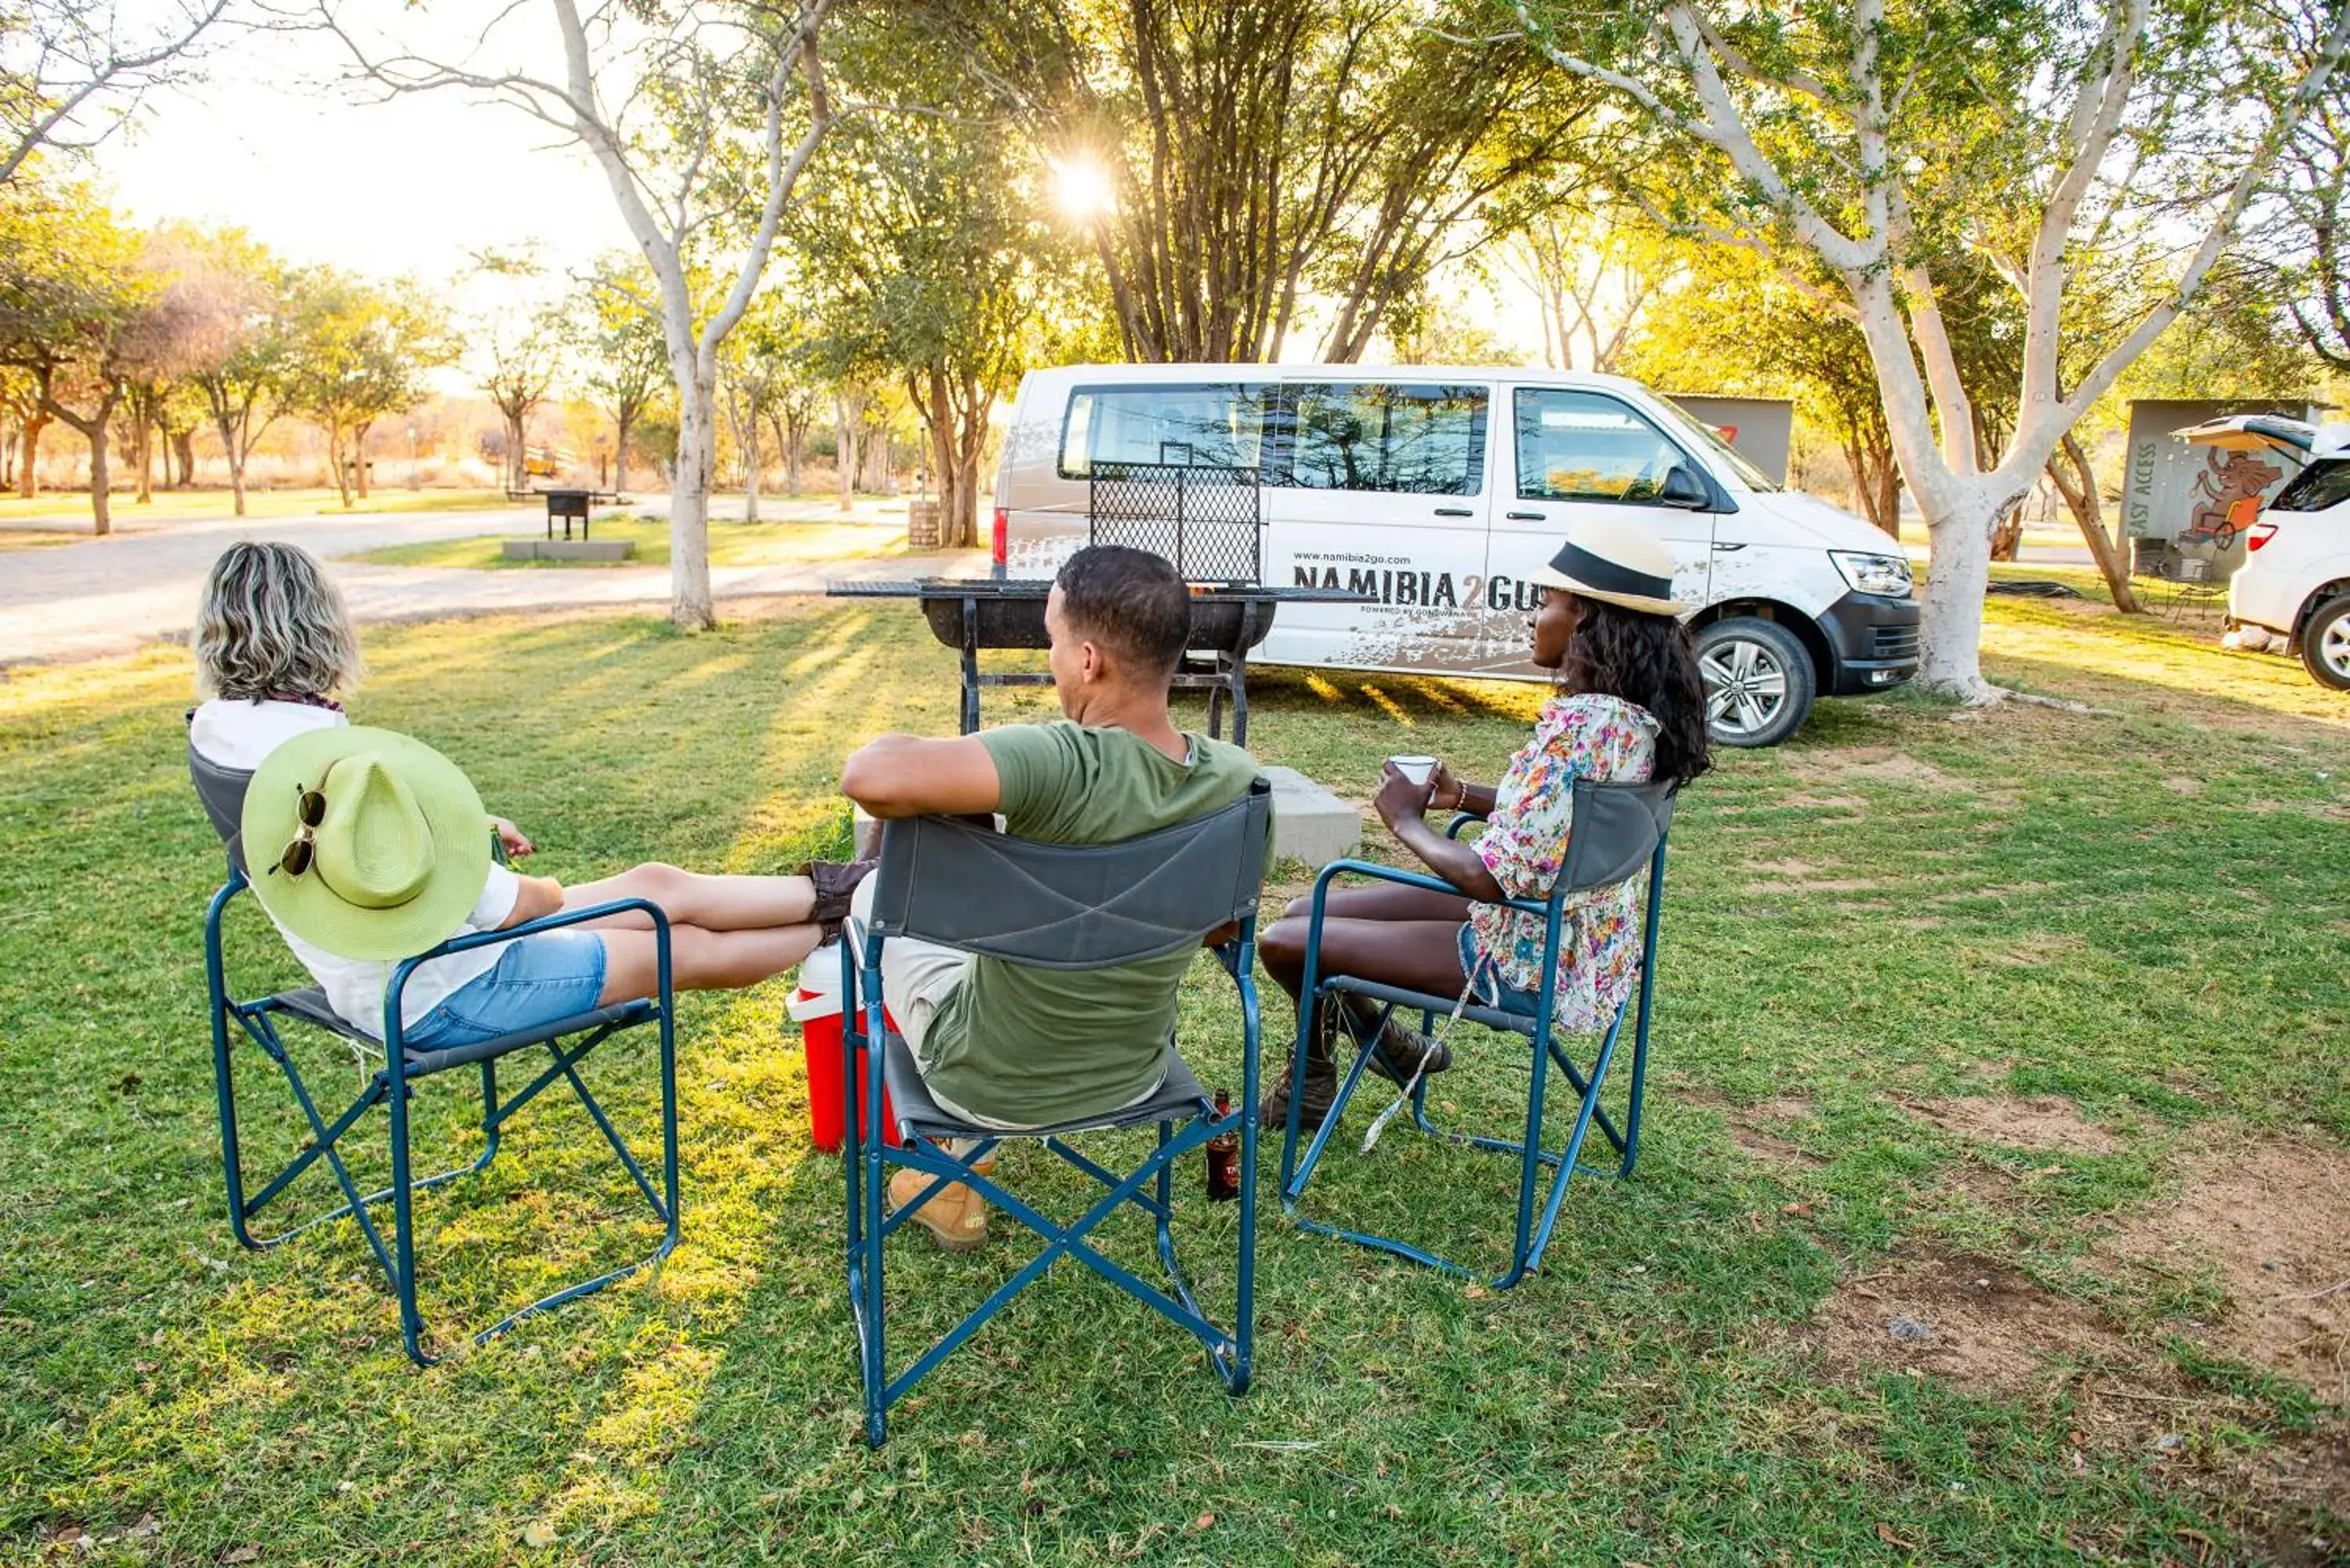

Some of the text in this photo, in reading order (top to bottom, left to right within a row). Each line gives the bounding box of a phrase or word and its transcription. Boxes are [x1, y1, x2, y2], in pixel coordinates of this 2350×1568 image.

[2128, 443, 2157, 537] EASY ACCESS
[1293, 551, 1411, 565] www.namibia2go.com
[1361, 605, 1401, 615] POWERED
[1415, 609, 1466, 618] GONDWANA
